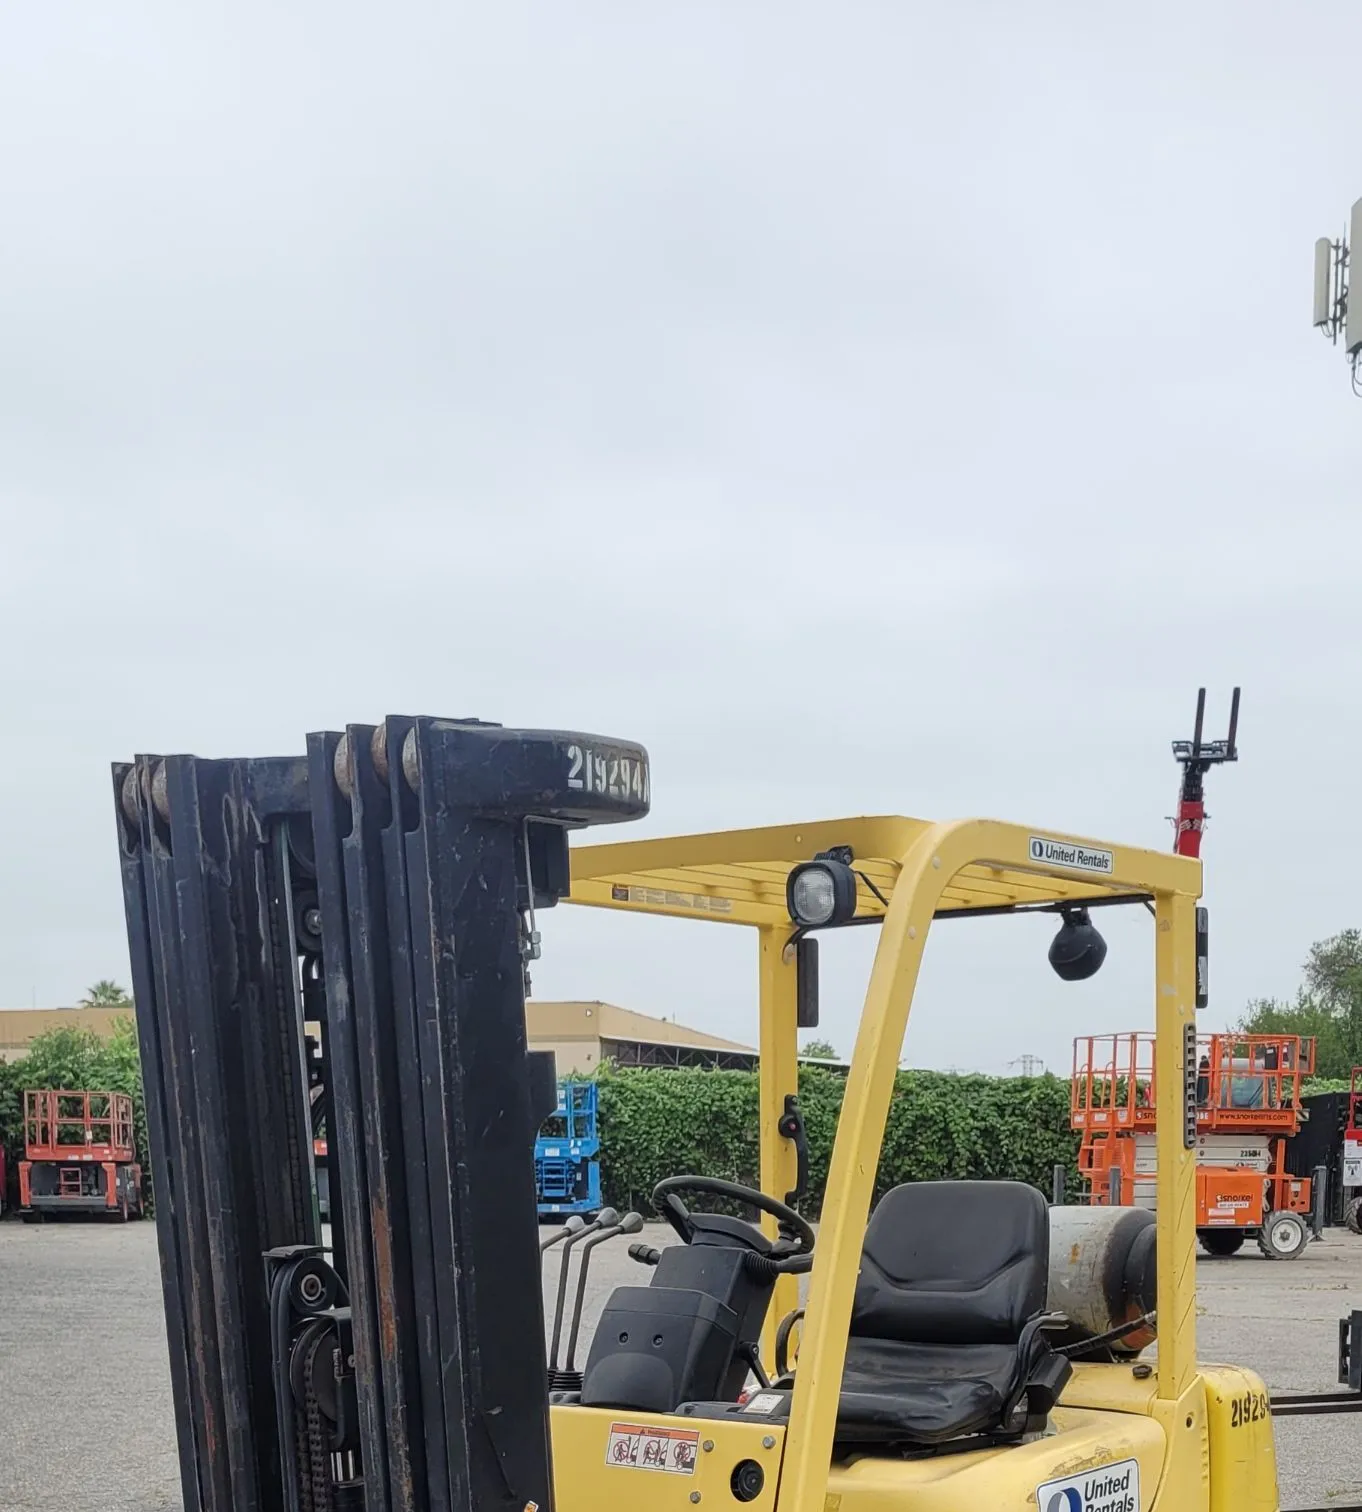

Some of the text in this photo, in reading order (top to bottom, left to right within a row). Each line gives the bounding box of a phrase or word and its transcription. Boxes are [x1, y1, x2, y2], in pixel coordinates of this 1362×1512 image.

[1045, 844, 1109, 869] United Rentals
[1084, 1469, 1130, 1502] United
